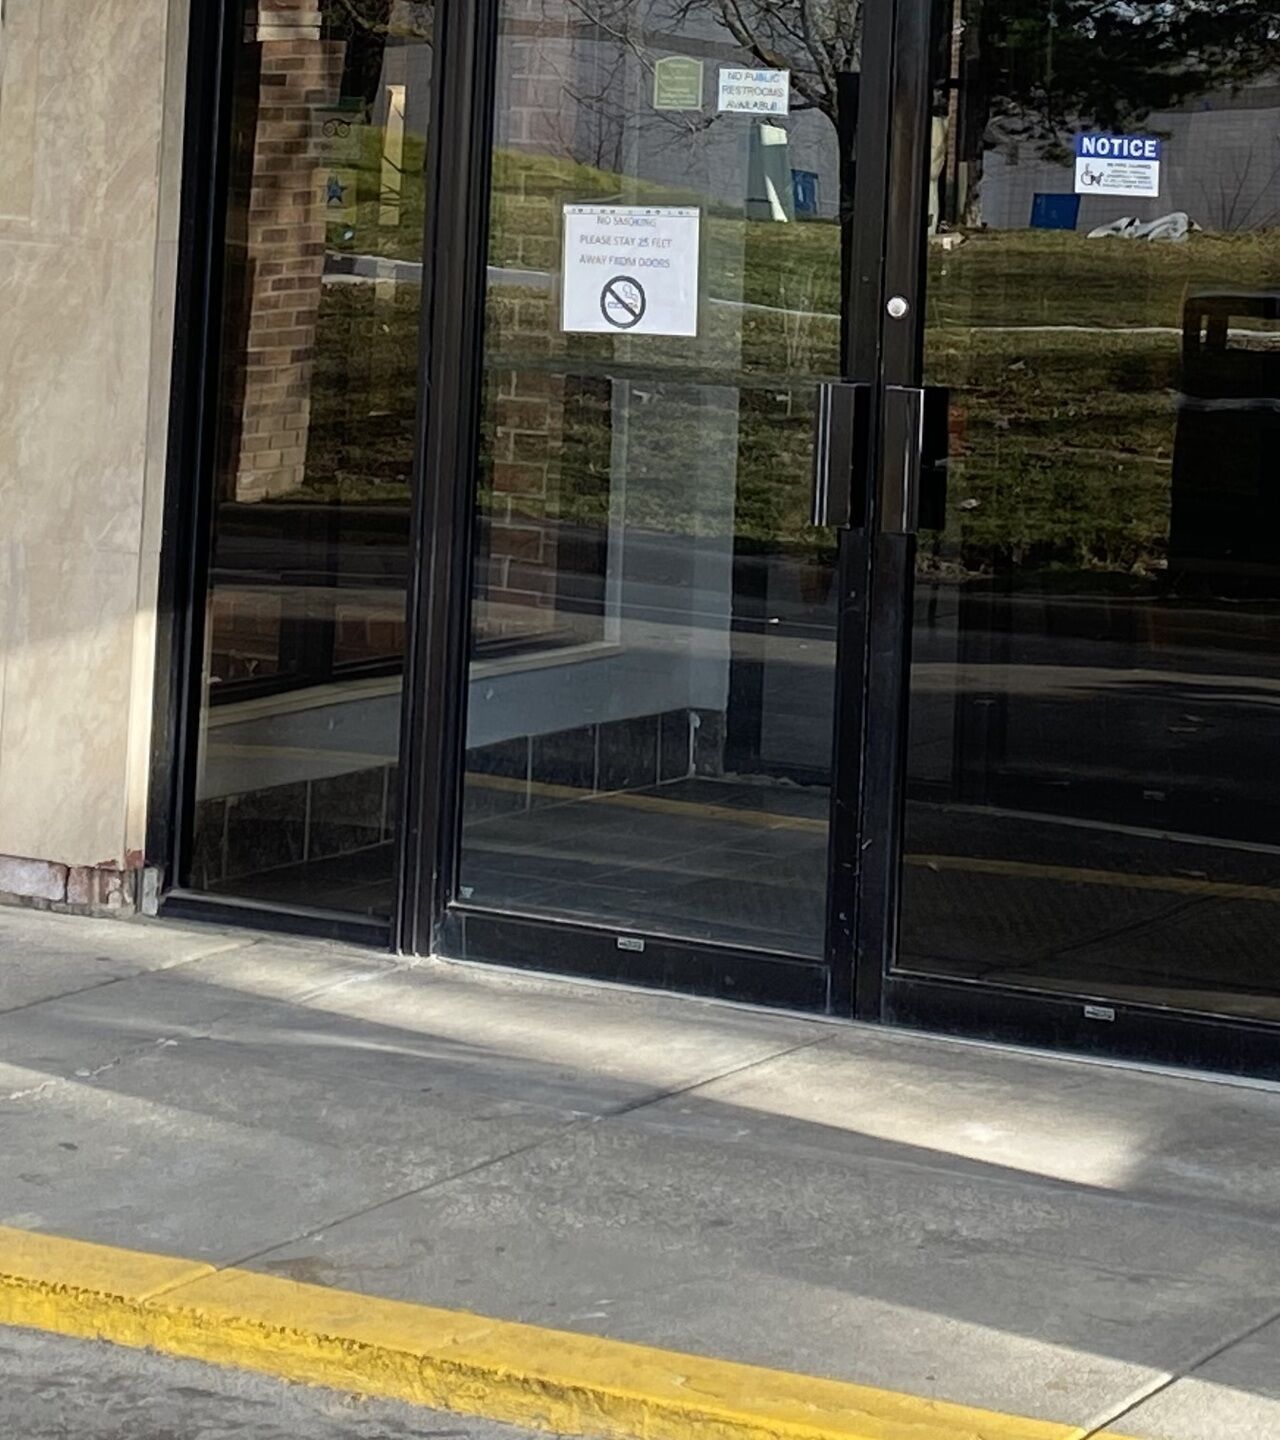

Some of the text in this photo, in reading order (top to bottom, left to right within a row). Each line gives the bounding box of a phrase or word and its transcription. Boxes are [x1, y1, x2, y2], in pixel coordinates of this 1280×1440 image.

[727, 71, 780, 83] NO PUBLIC
[722, 85, 785, 98] RESTROOMS
[1081, 136, 1157, 158] NOTICE
[596, 215, 657, 227] NO SMOKING
[579, 235, 611, 245] PLEASE
[613, 236, 636, 246] STAY
[579, 254, 608, 264] AWAY
